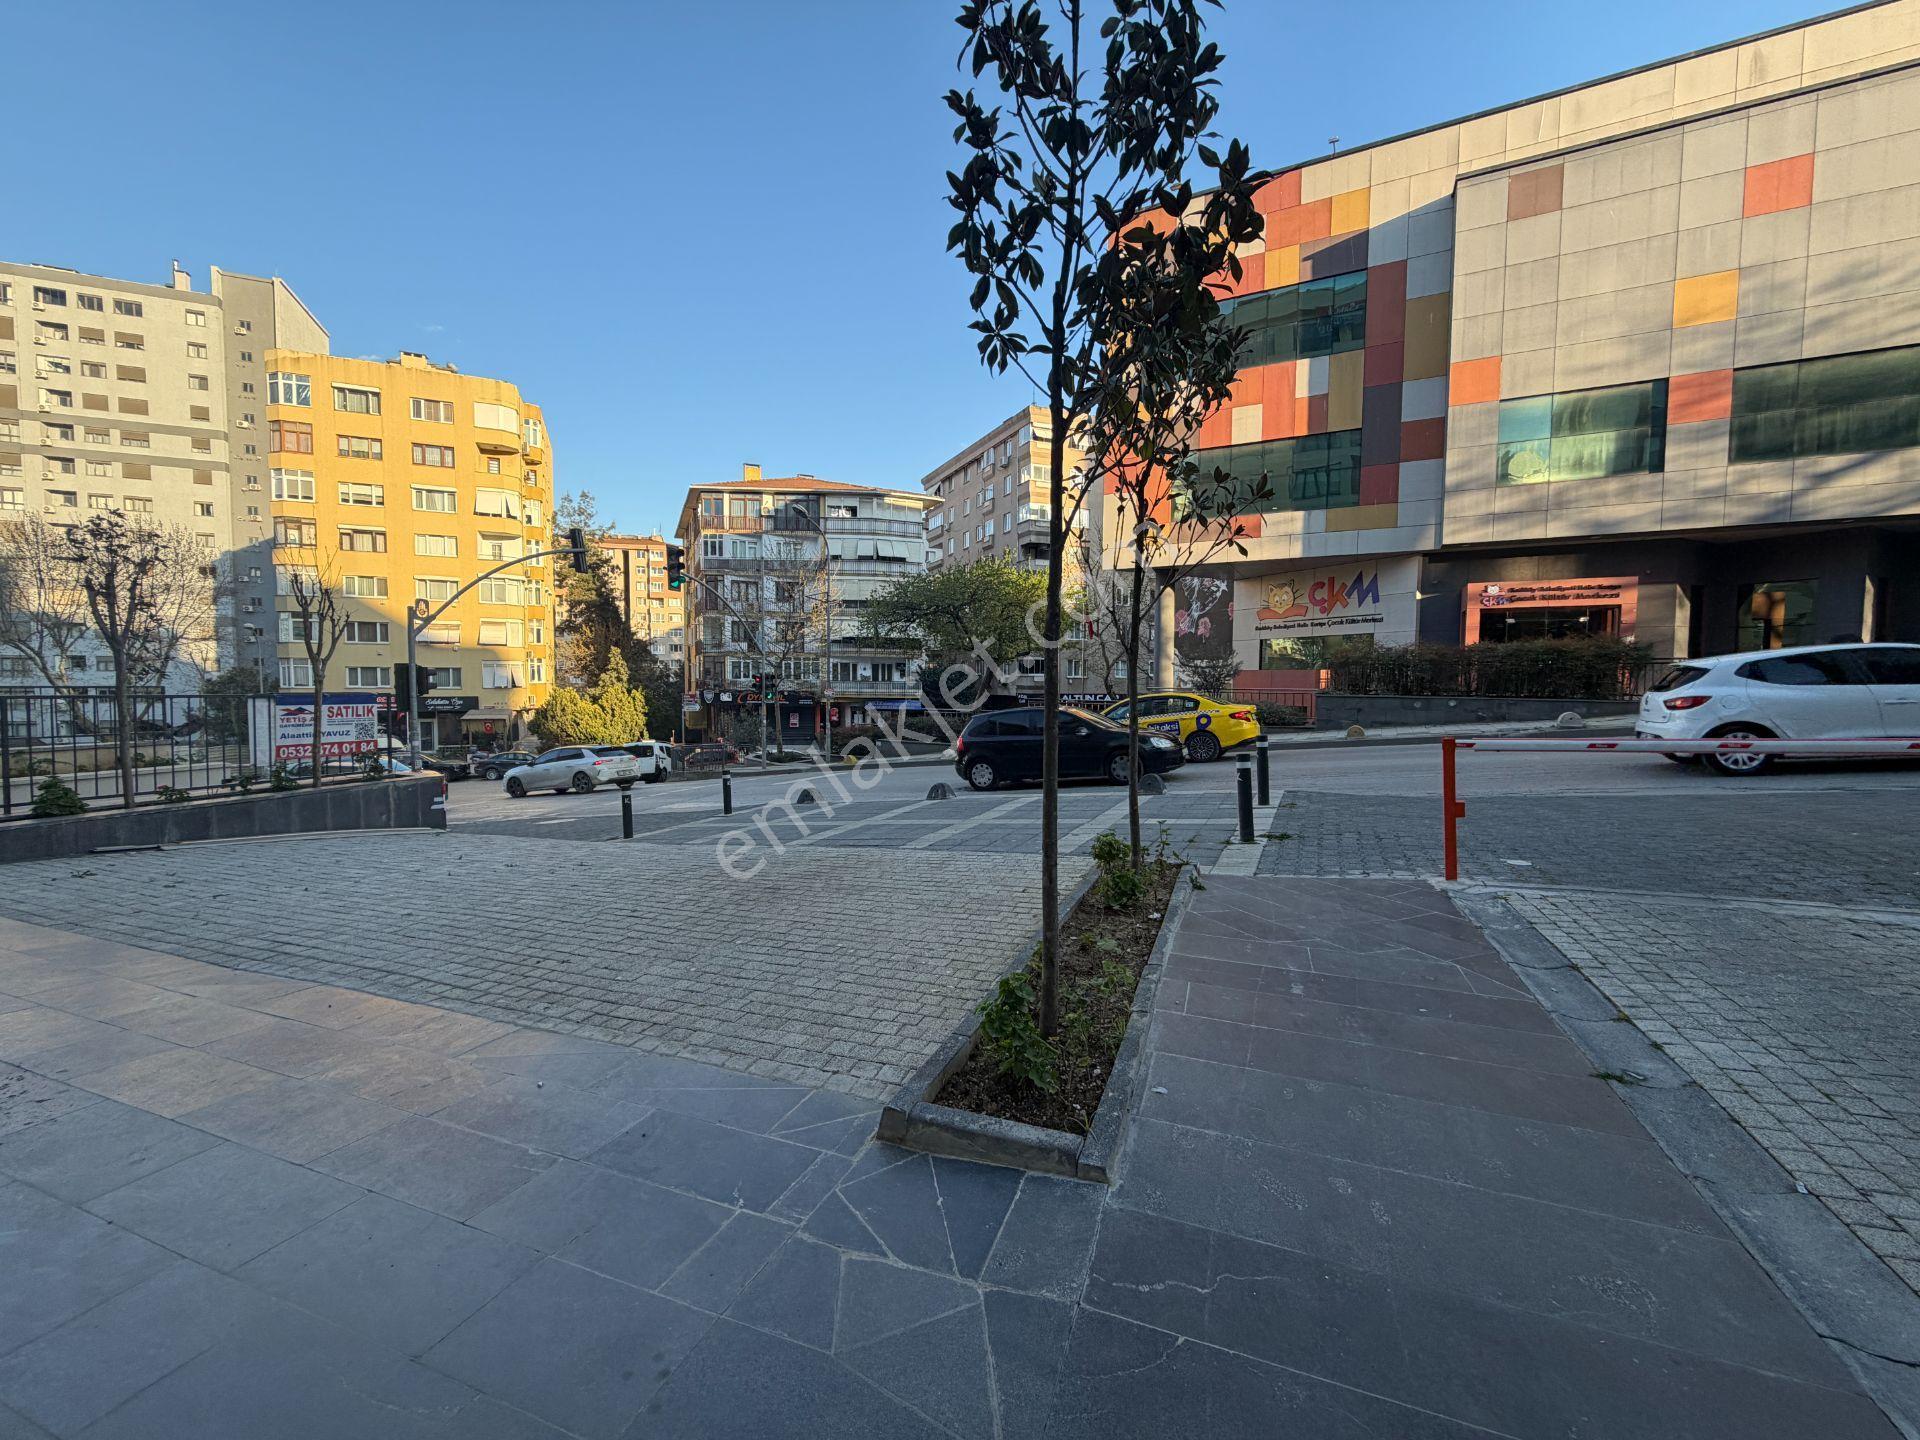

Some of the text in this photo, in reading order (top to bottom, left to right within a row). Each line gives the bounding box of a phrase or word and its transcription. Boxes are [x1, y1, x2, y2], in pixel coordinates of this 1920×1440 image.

[327, 705, 375, 719] SATILIK
[280, 732, 315, 740] Alaatti
[280, 746, 313, 758] 0532
[342, 743, 357, 754] 01
[360, 741, 375, 753] 84
